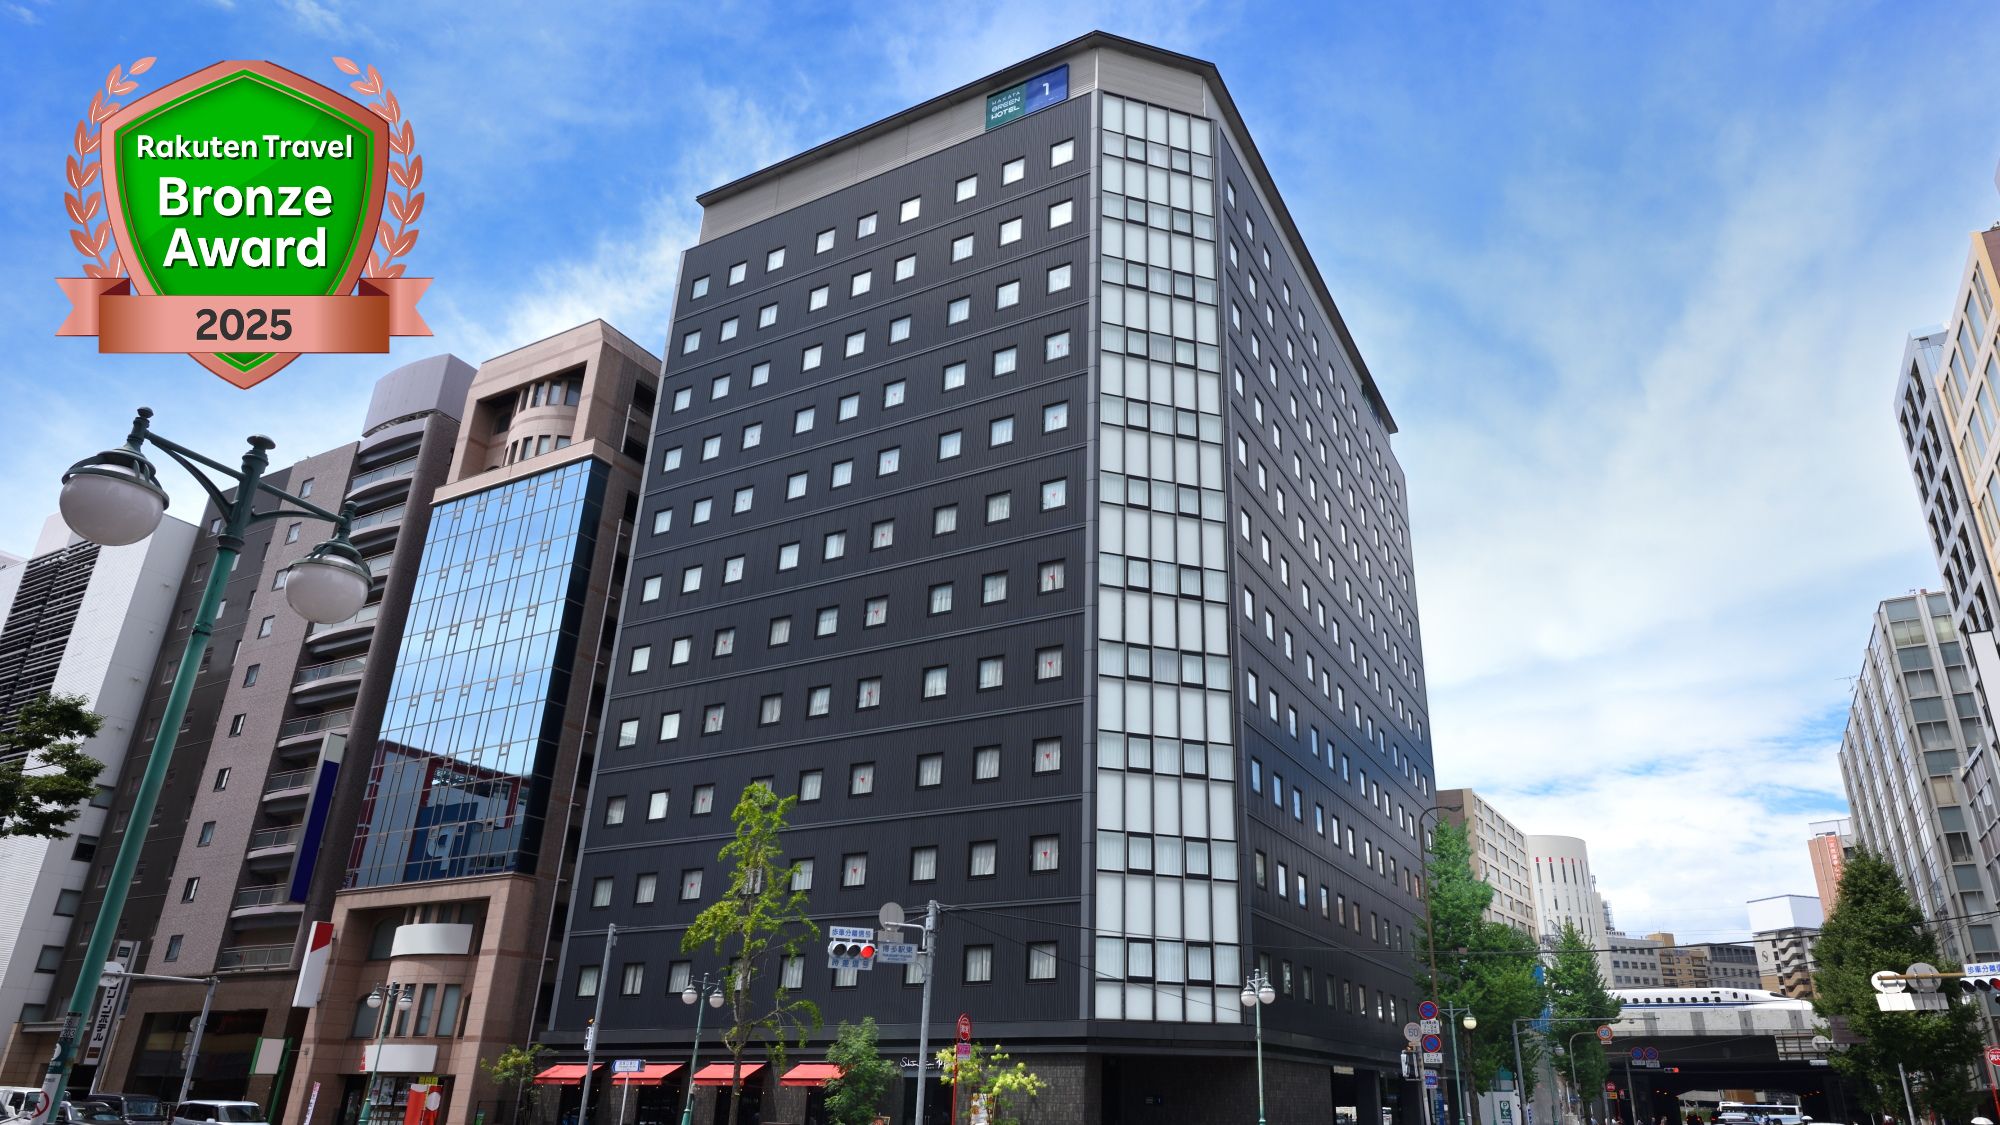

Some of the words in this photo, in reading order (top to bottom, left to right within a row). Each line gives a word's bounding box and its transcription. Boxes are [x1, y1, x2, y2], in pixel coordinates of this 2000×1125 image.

[1042, 82, 1050, 96] 1
[991, 91, 1020, 105] HAKATA
[991, 97, 1021, 112] GREEN
[991, 107, 1020, 120] HOTEL
[1408, 1028, 1419, 1037] 50
[1600, 1029, 1610, 1037] 50
